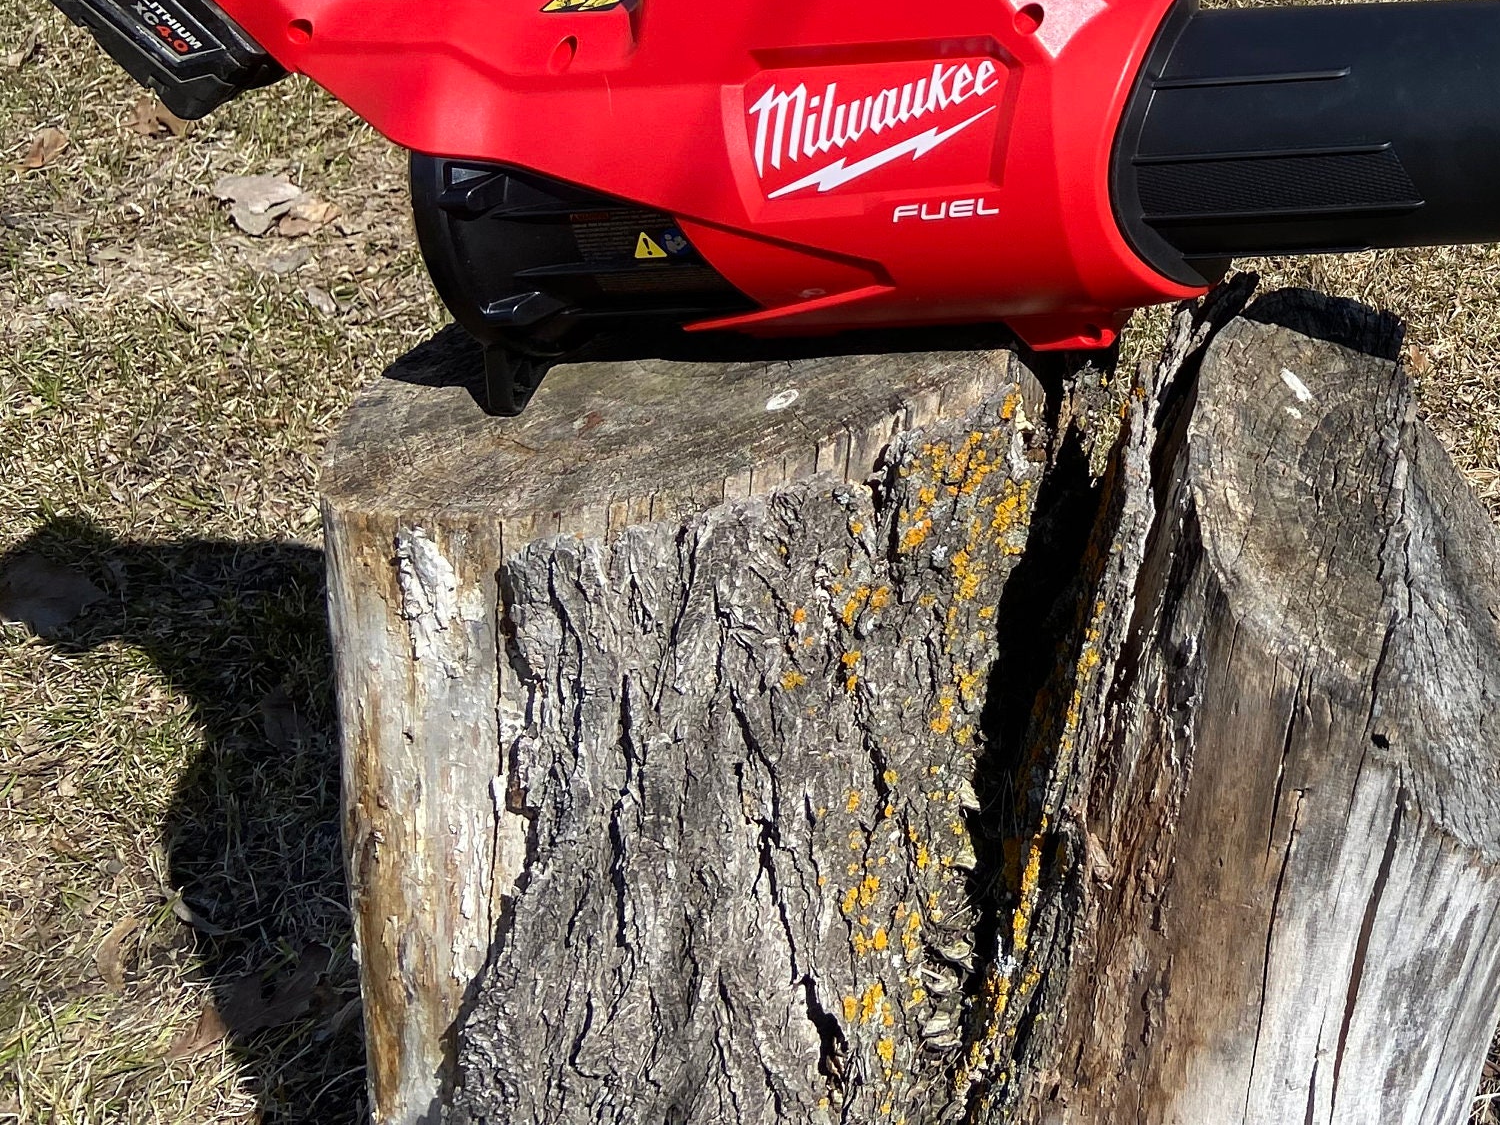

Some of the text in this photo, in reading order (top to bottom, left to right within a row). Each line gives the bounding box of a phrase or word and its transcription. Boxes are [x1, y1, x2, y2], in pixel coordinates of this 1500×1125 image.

[130, 0, 190, 53] XC4.0
[749, 60, 999, 179] Milwaukee
[892, 198, 1000, 224] FUEL
